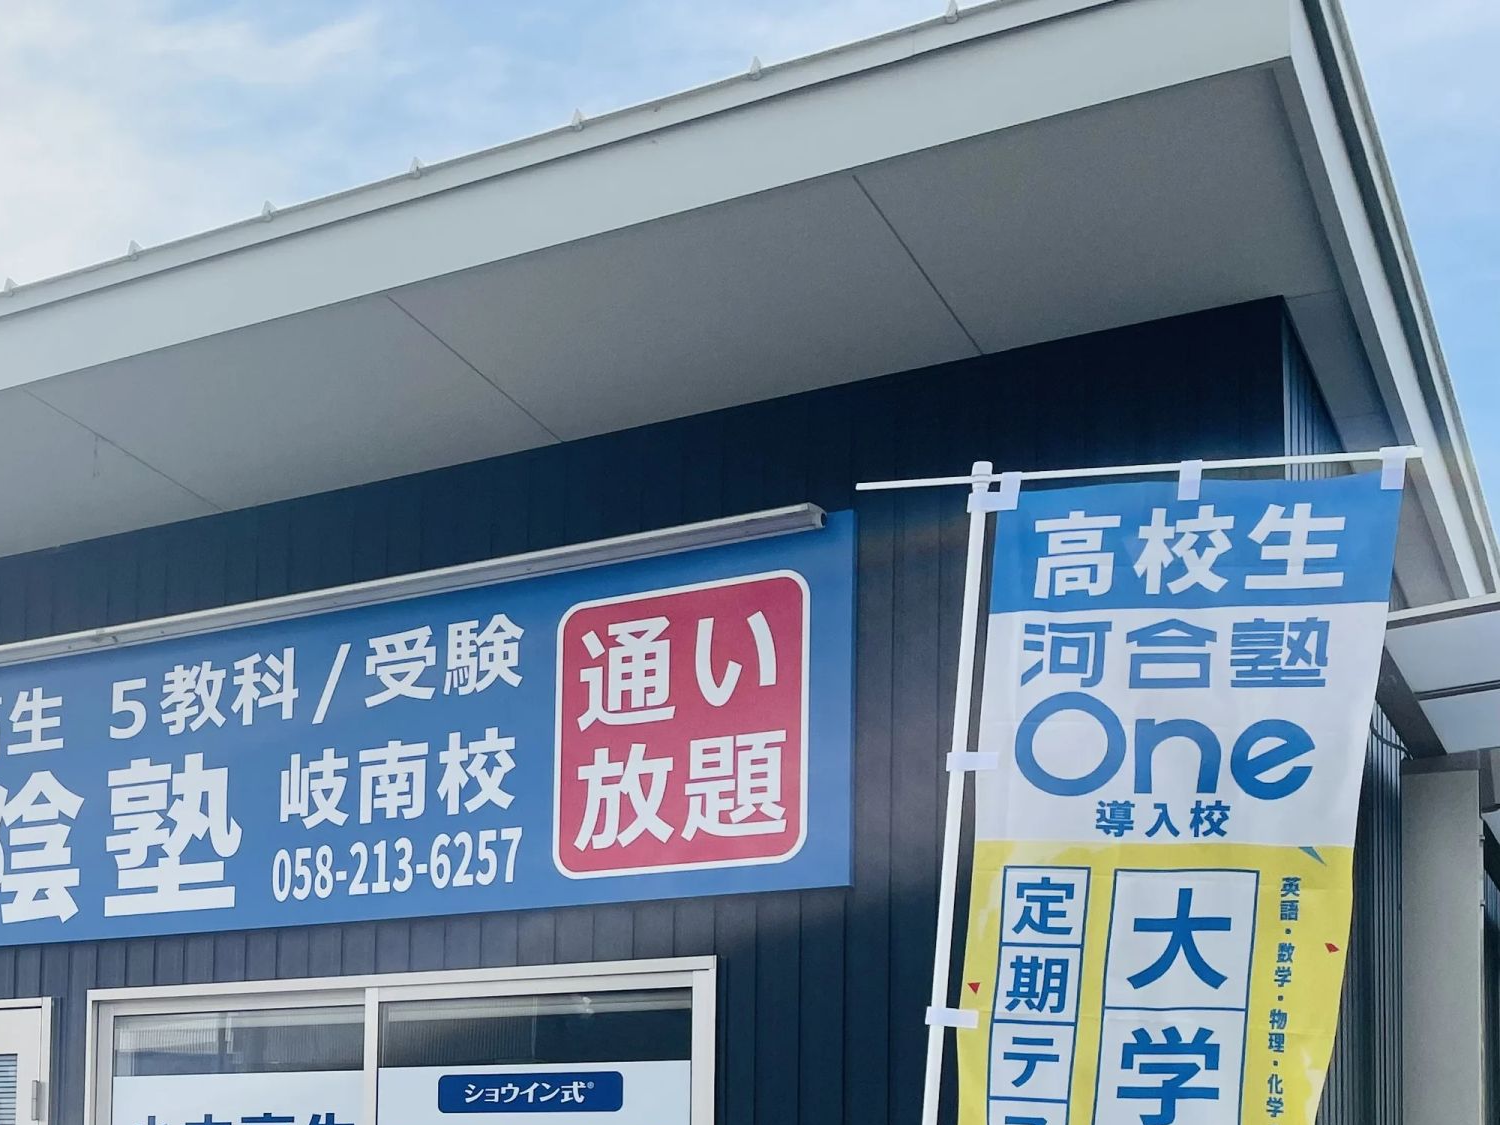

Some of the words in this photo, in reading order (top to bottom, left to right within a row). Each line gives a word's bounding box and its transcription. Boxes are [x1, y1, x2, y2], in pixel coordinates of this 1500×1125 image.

[1033, 503, 1346, 599] 高校生
[577, 611, 777, 731] 通い
[1021, 617, 1330, 688] 河合塾
[279, 727, 517, 830] 岐南校
[573, 730, 787, 851] 放題
[1015, 692, 1315, 800] One
[272, 827, 524, 902] 058-213-6257
[1096, 801, 1230, 838] 導入校
